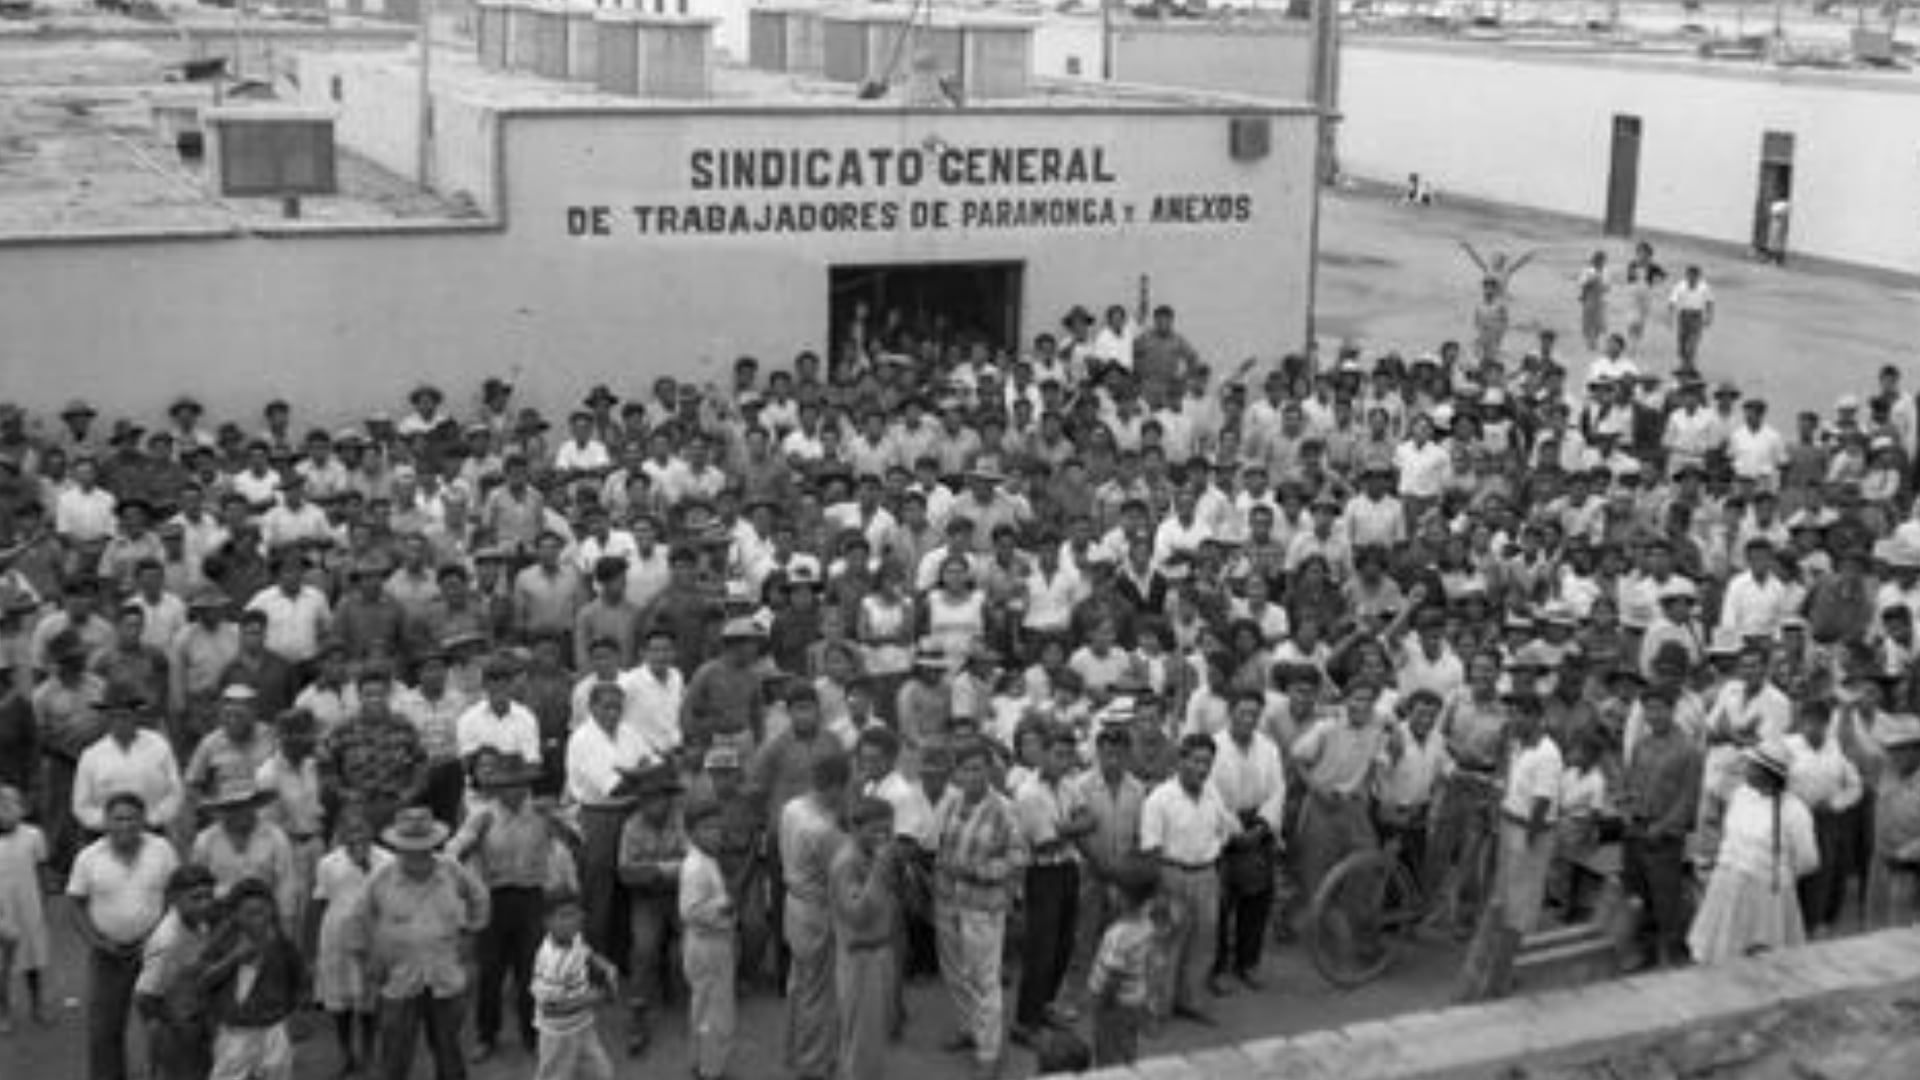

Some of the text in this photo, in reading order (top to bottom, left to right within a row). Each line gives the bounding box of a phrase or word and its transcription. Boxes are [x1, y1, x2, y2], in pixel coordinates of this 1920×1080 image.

[690, 146, 1117, 190] SINDICATO GENERAL
[566, 205, 612, 237] DE
[632, 200, 901, 235] TRABAJADORES
[910, 200, 950, 230] DE
[961, 196, 1117, 229] PARAMONGA
[1150, 192, 1253, 224] ANEXOS
